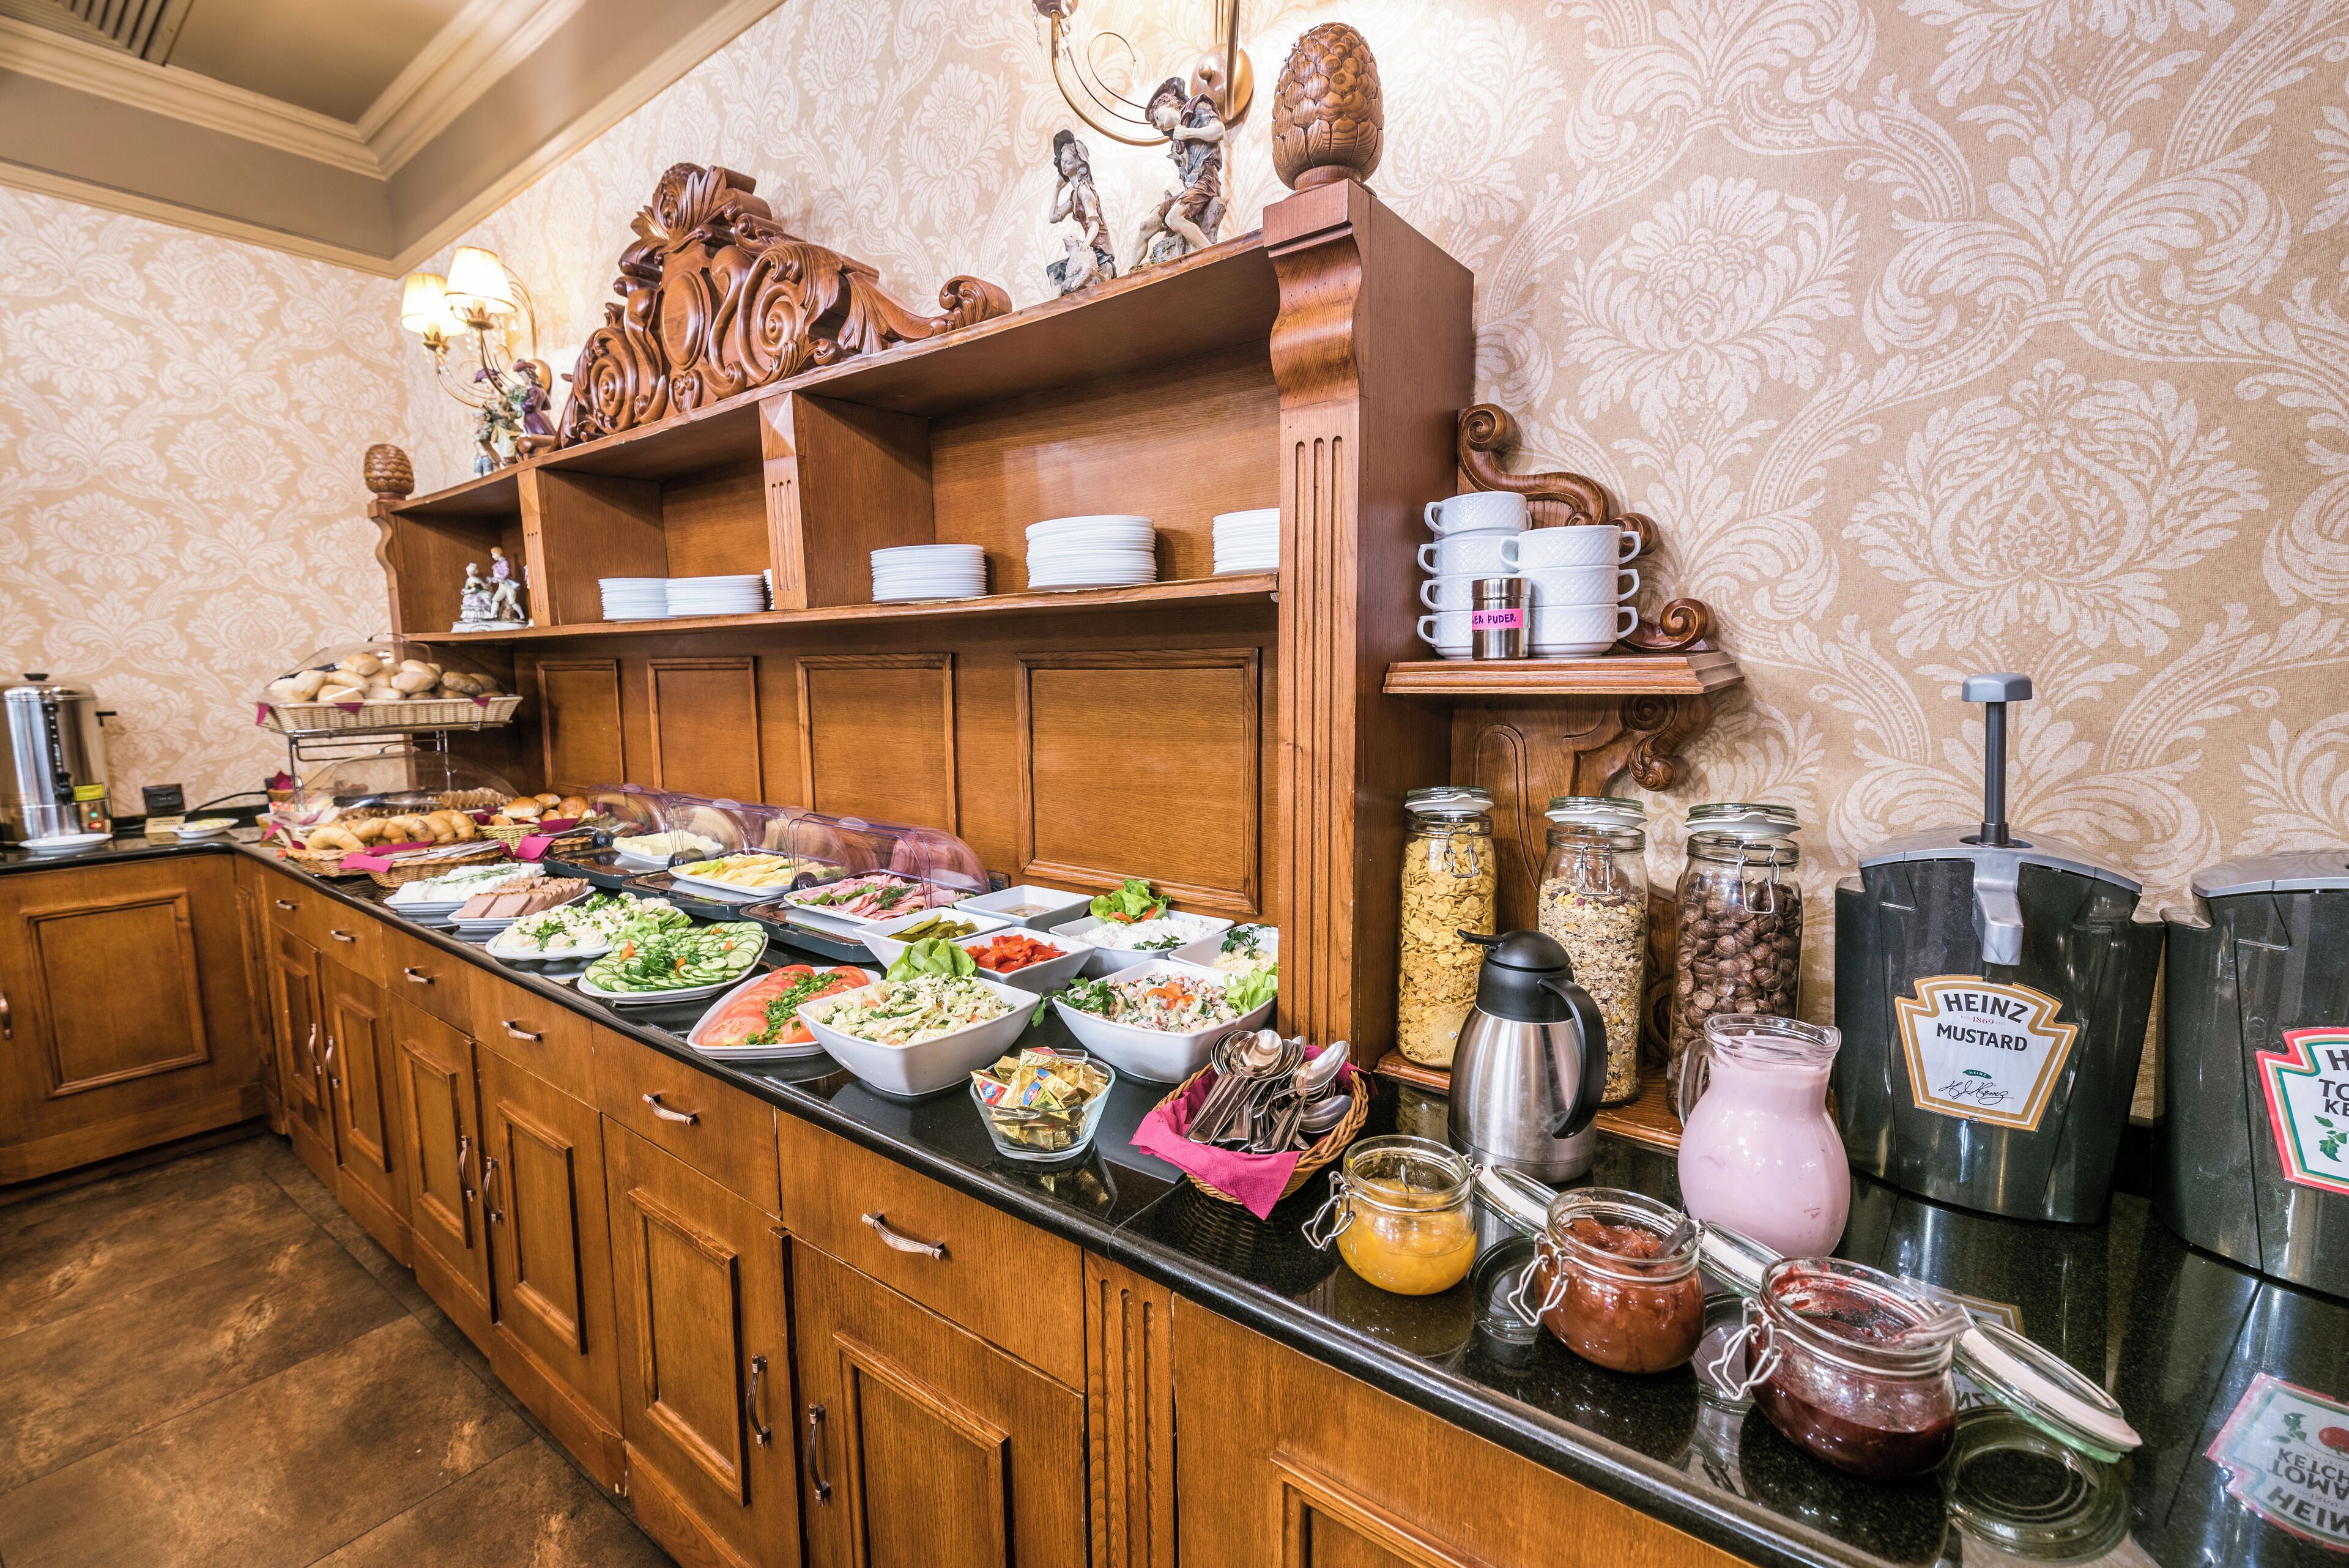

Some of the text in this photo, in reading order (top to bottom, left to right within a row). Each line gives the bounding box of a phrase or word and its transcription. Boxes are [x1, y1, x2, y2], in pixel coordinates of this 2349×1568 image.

[1488, 613, 1516, 624] PUDER
[1943, 993, 2028, 1024] HEINZ
[1972, 1016, 1994, 1025] 1869
[1936, 1022, 2028, 1052] MUSTARD
